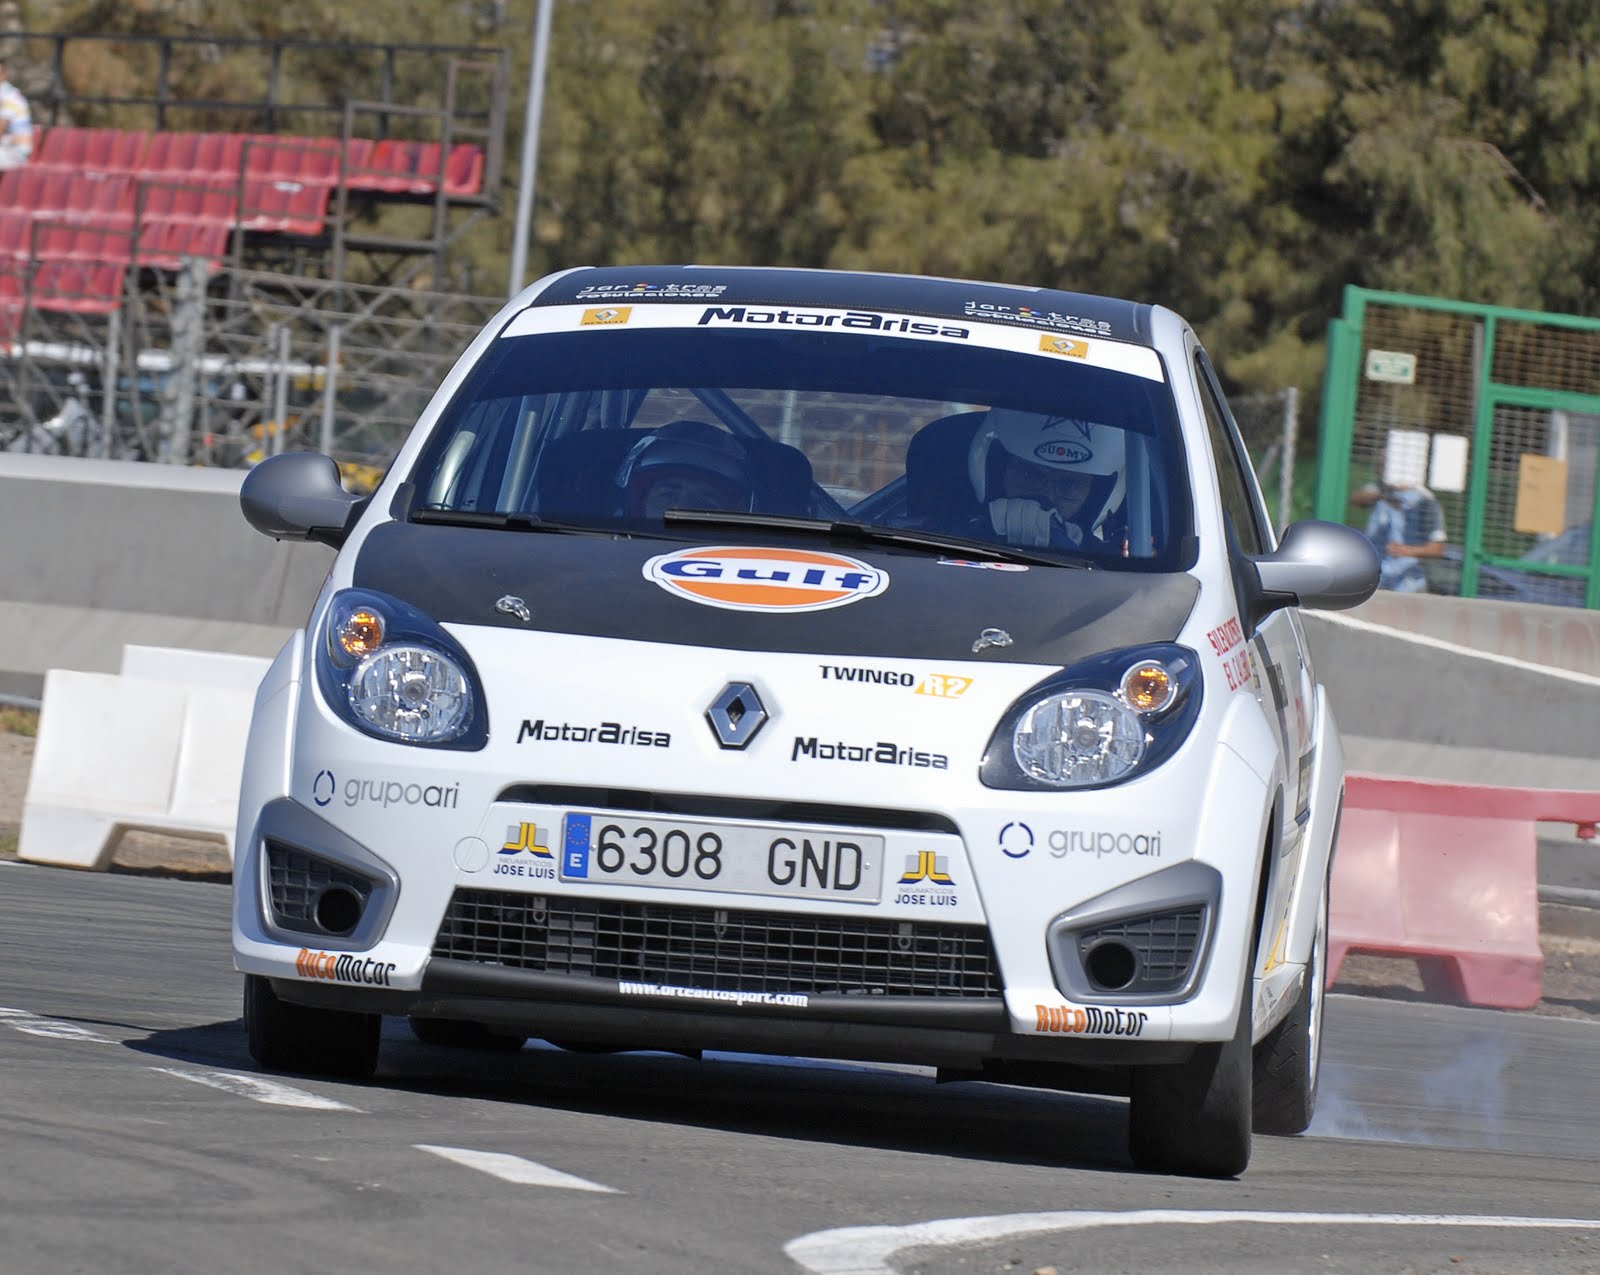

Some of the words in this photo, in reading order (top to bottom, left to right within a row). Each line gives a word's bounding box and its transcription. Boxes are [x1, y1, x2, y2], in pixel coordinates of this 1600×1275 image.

[1040, 445, 1088, 460] SUOMY
[660, 558, 875, 590] Gulf
[818, 664, 914, 687] TWINGO
[921, 674, 968, 697] R2
[344, 777, 460, 809] grupoari
[597, 824, 723, 880] 6308
[767, 837, 863, 891] GND
[1048, 829, 1162, 859] grupoari
[494, 863, 525, 877] JOSE
[528, 867, 556, 880] LUIS
[569, 853, 583, 868] E
[894, 894, 926, 905] JOSE
[930, 895, 958, 906] LUIS
